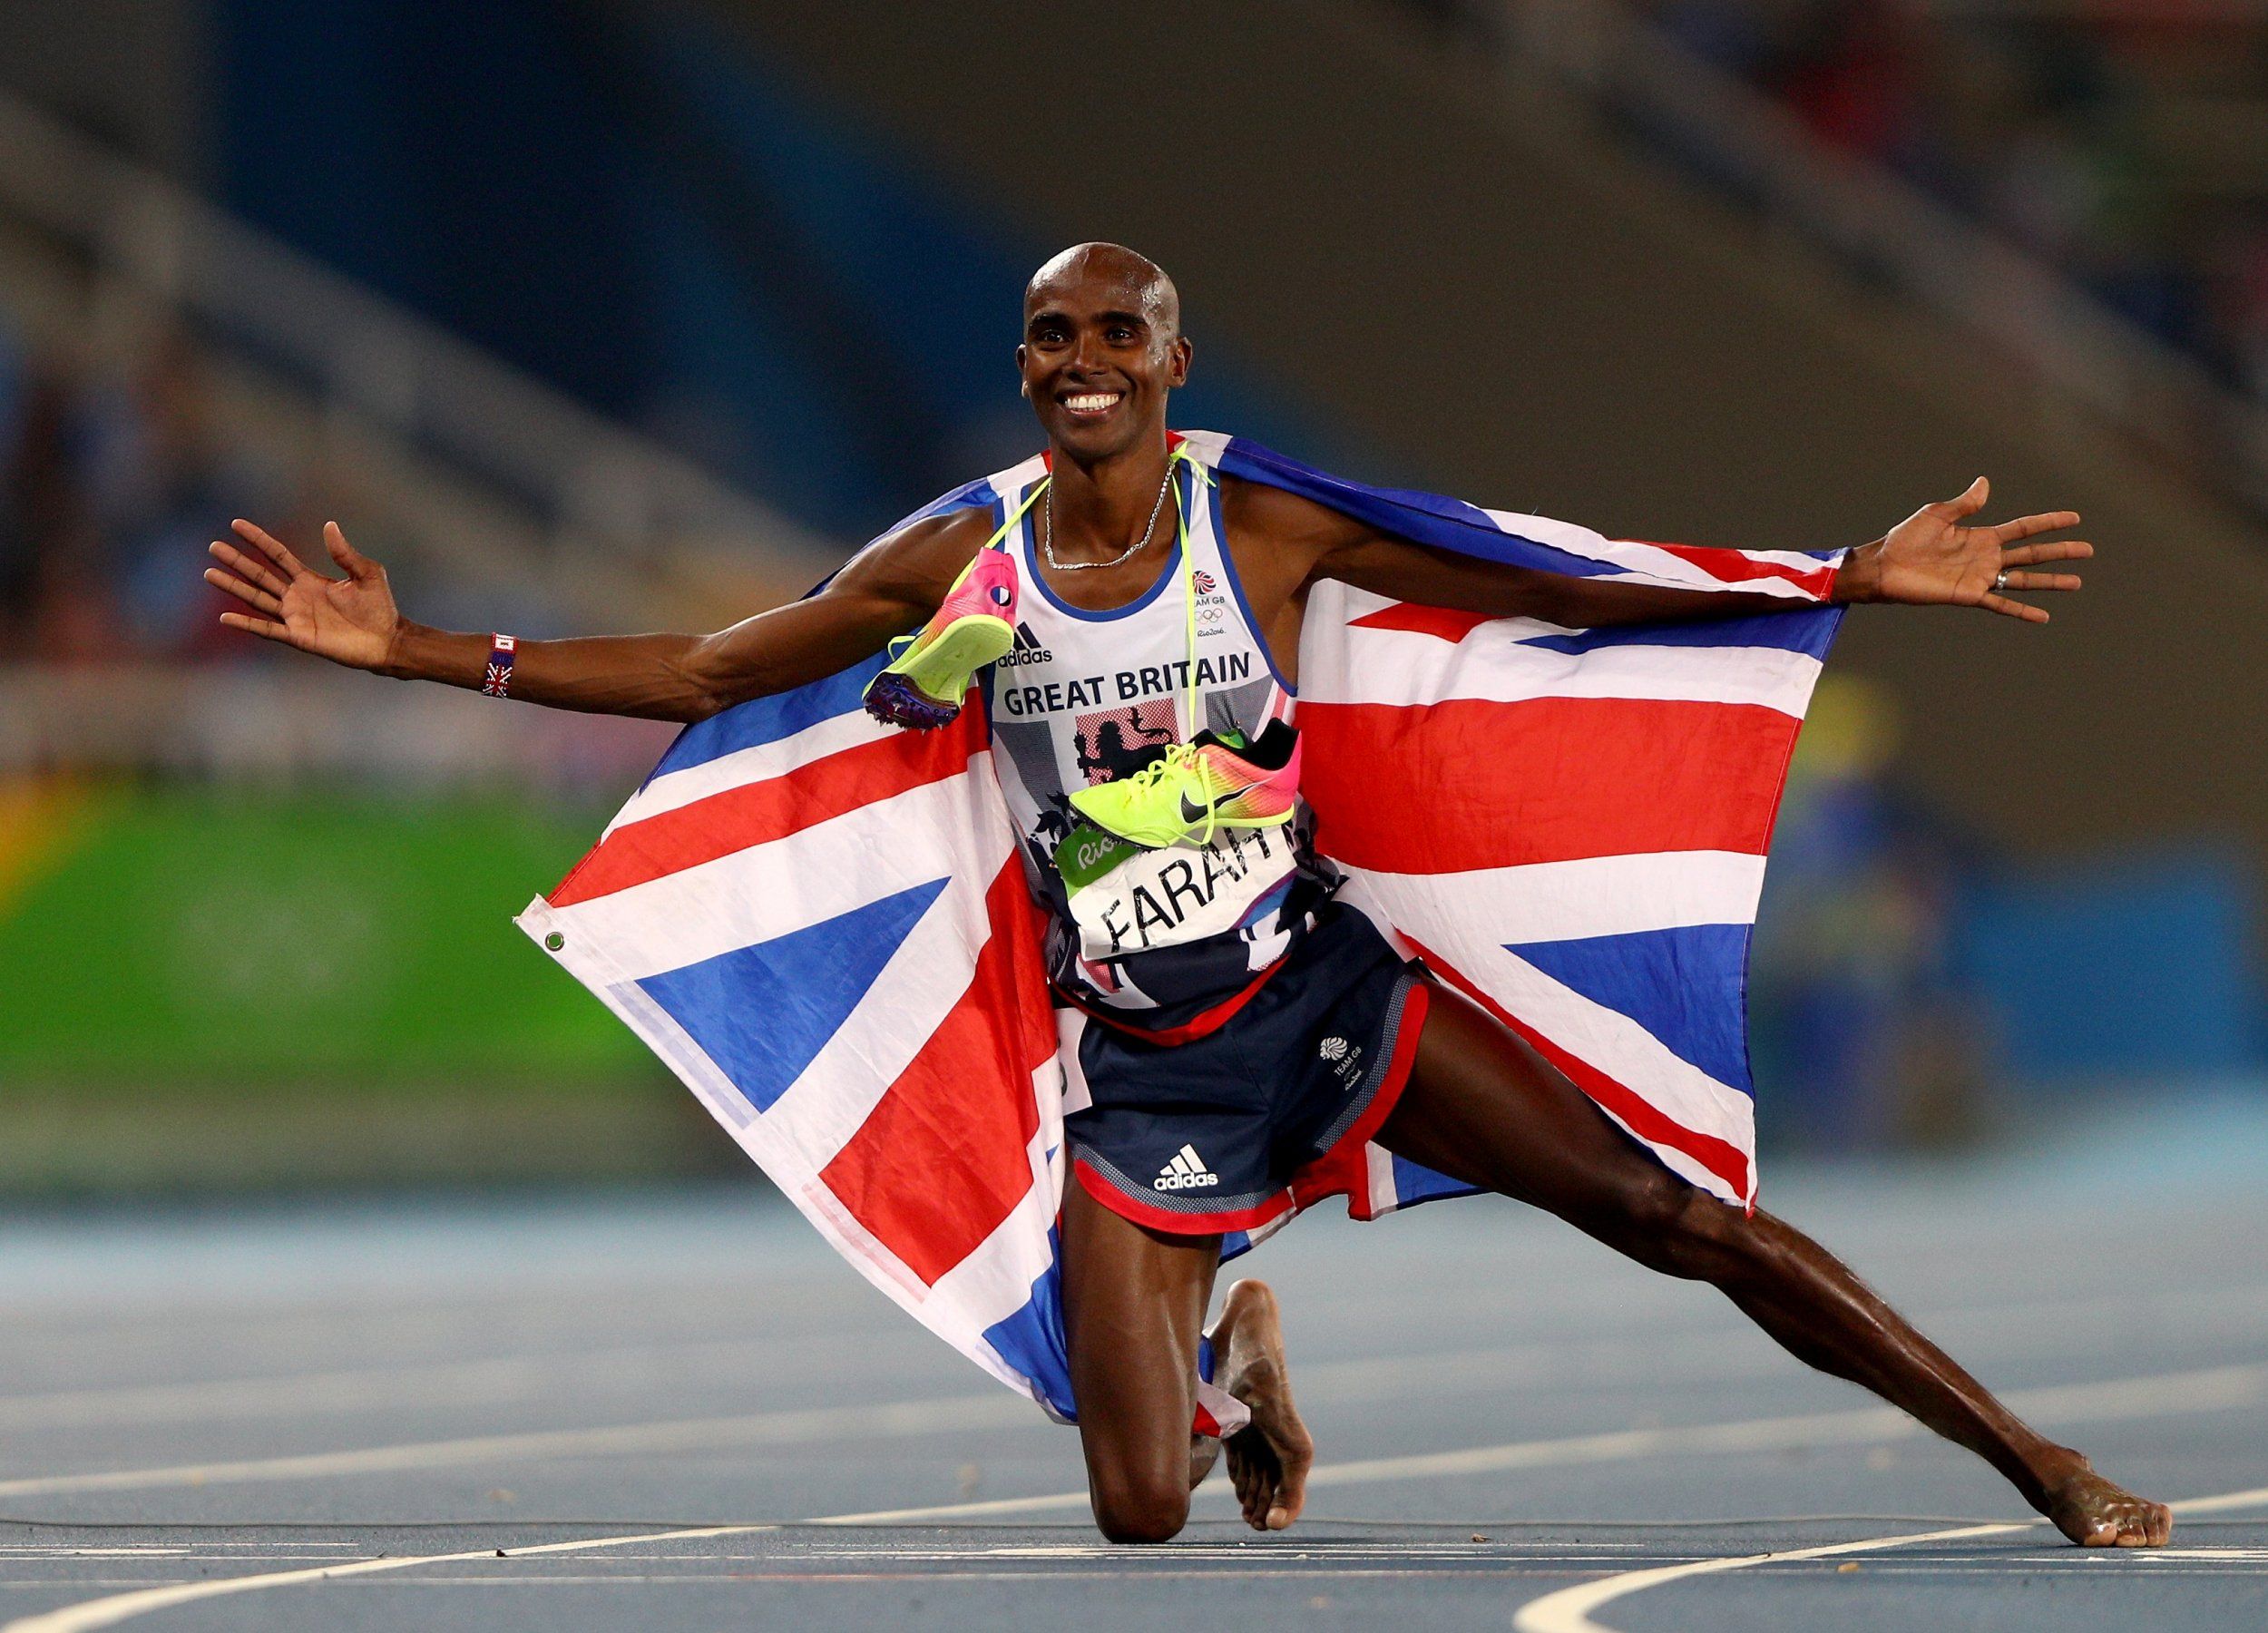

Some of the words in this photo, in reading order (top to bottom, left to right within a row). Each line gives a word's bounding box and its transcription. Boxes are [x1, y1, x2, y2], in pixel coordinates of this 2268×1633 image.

[1212, 596, 1226, 605] GB
[998, 648, 1052, 668] adidas
[1004, 677, 1105, 717] GREAT
[1115, 652, 1250, 700] BRITAIN
[1100, 825, 1271, 953] FARAH
[1334, 1056, 1353, 1076] TEAM
[1352, 1046, 1362, 1059] GB
[1154, 1171, 1218, 1191] adidas
